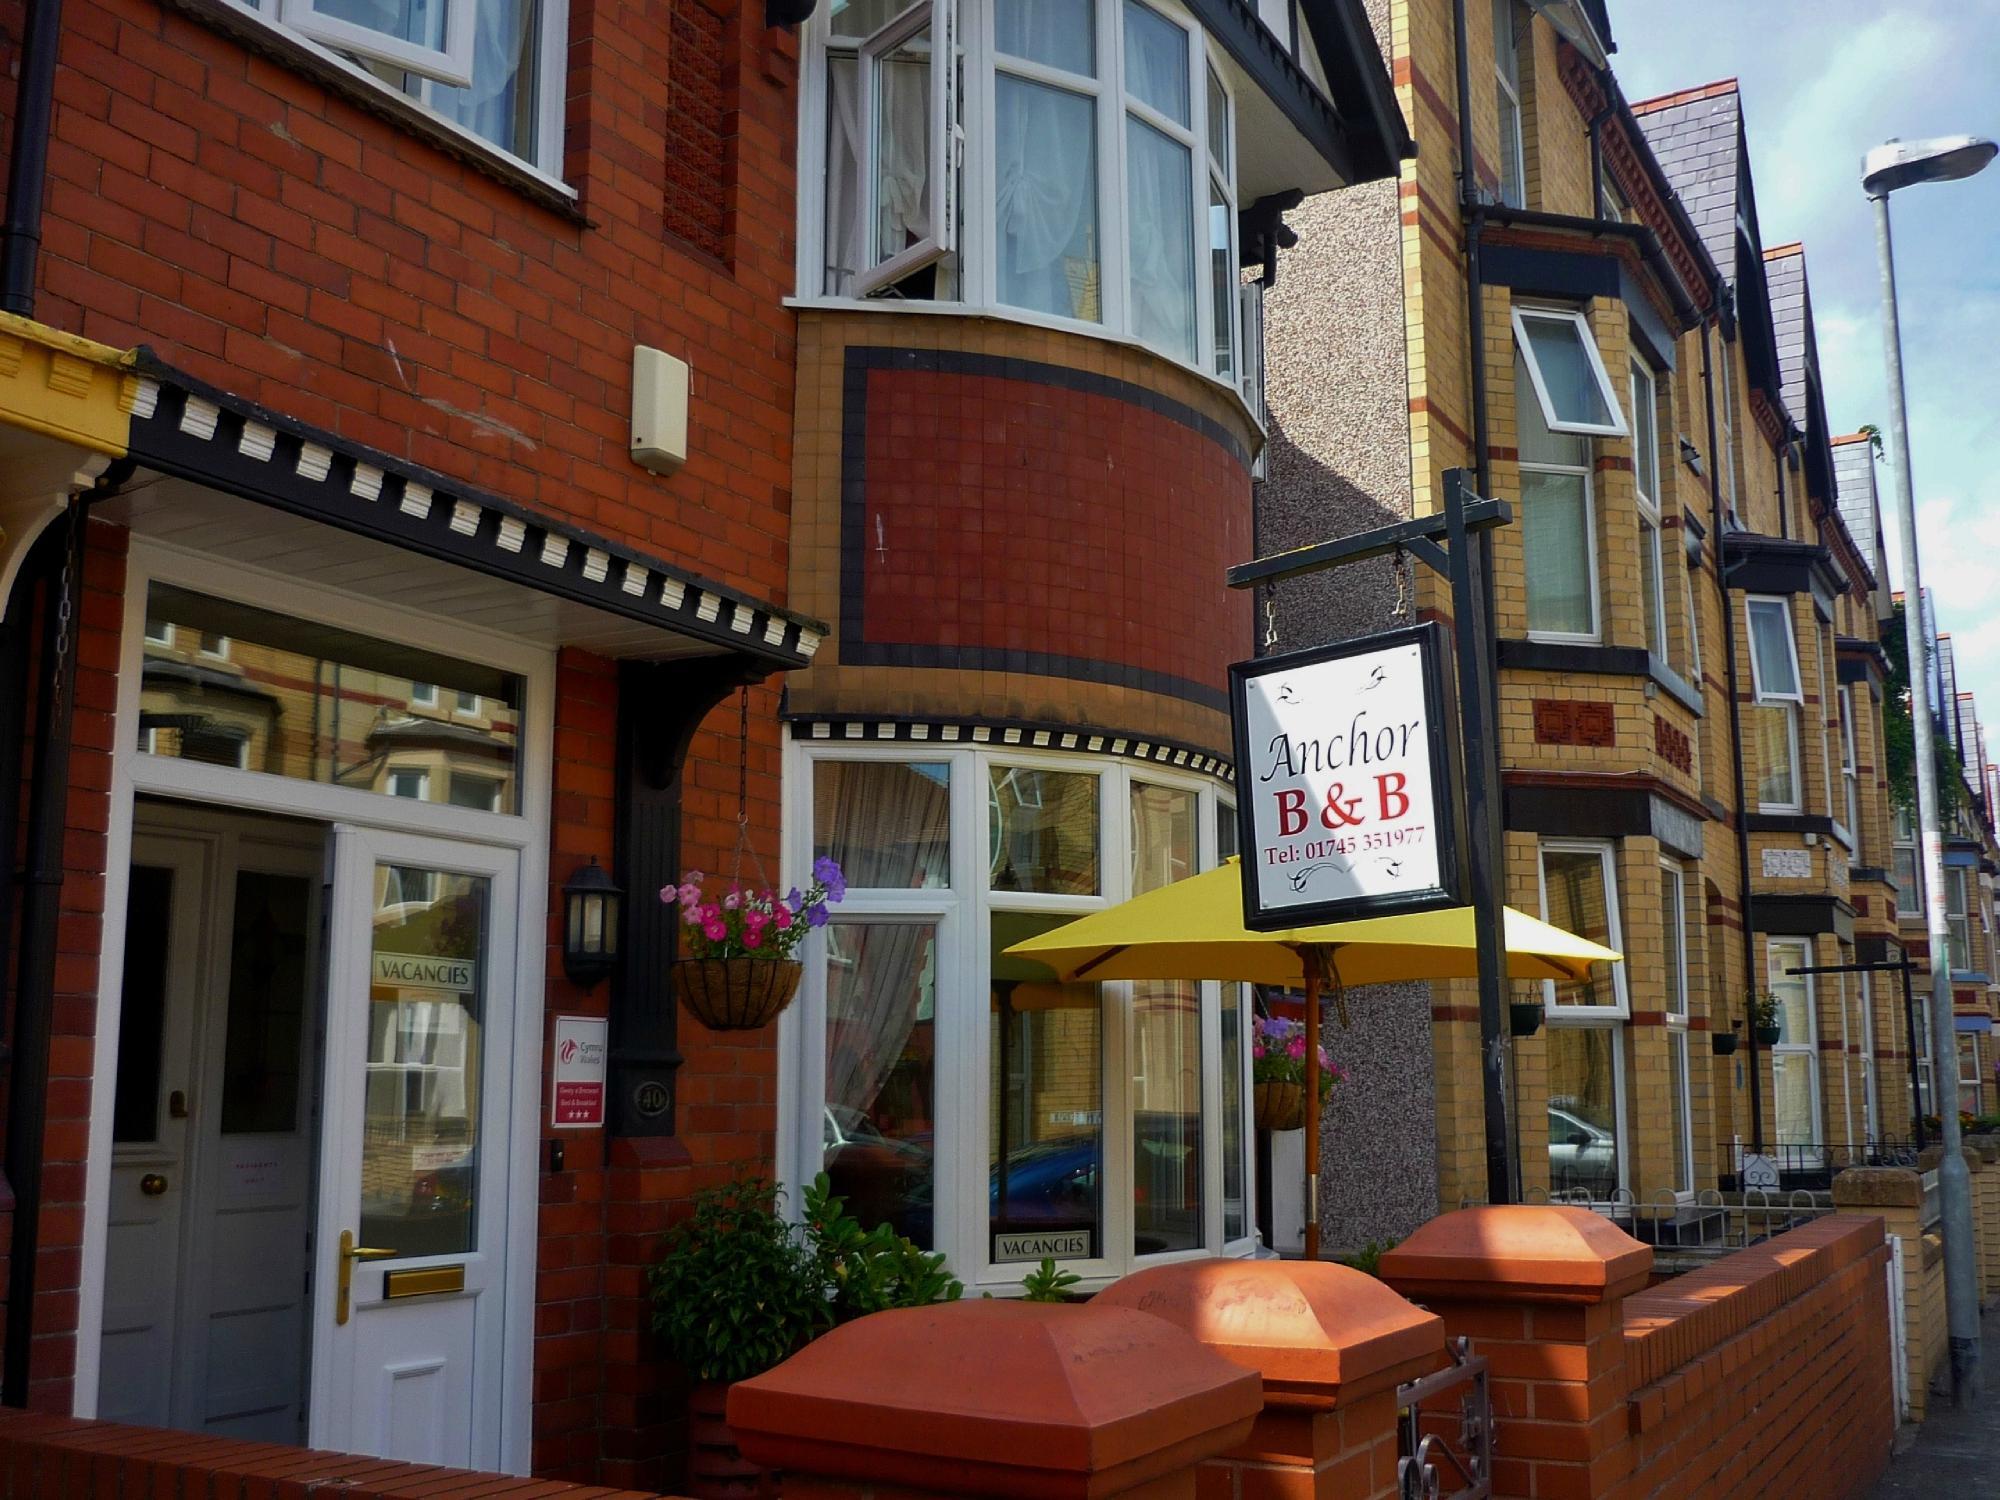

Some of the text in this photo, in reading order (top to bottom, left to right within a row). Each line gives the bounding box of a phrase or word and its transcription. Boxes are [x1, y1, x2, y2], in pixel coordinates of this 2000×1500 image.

[1260, 711, 1419, 782] Anchor
[1273, 772, 1410, 837] B & B
[1265, 826, 1425, 865] Tel: 01745 351977
[381, 960, 469, 985] VACANCIES
[1003, 1237, 1084, 1255] VACANCIES
